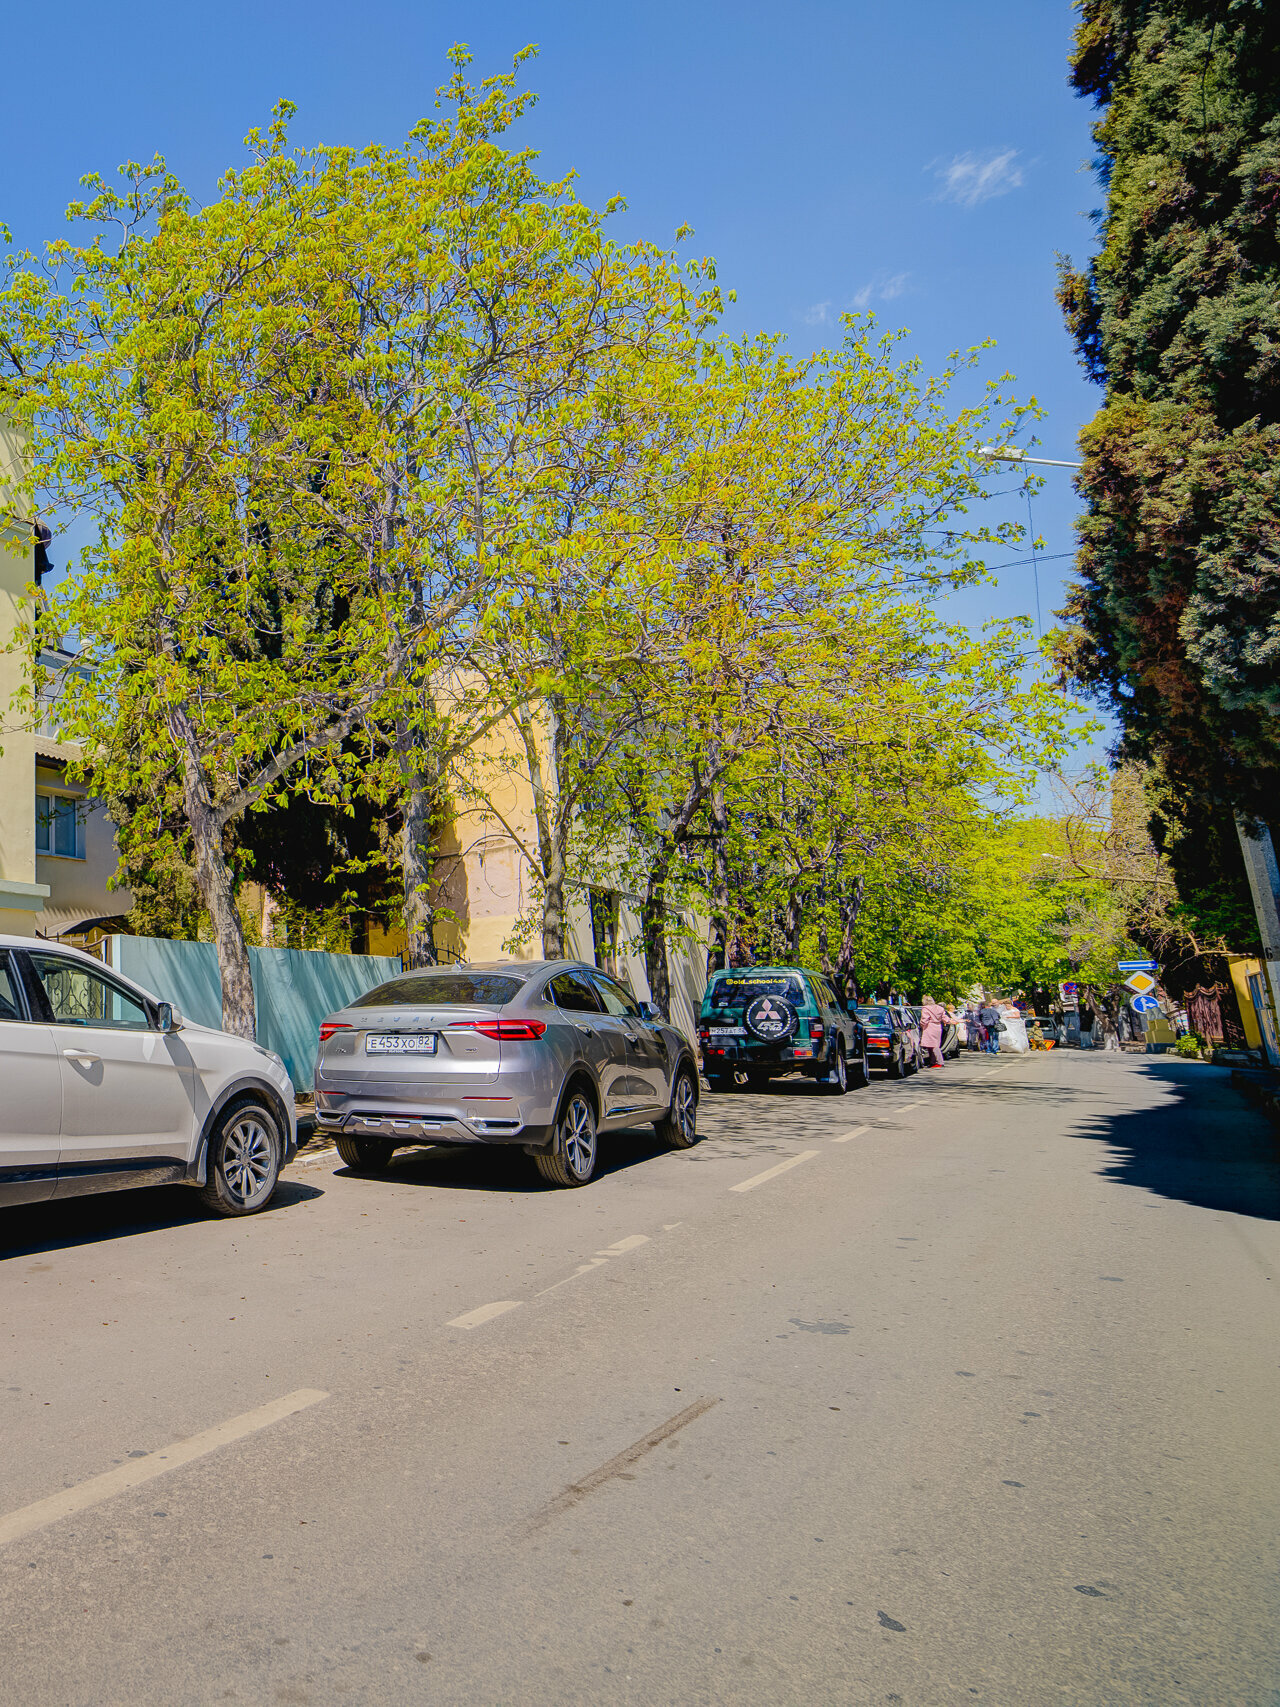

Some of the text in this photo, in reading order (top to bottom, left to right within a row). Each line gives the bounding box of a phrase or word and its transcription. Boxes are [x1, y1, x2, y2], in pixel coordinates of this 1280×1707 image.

[1264, 946, 1273, 960] 6
[370, 1035, 430, 1049] Е453ХО 82
